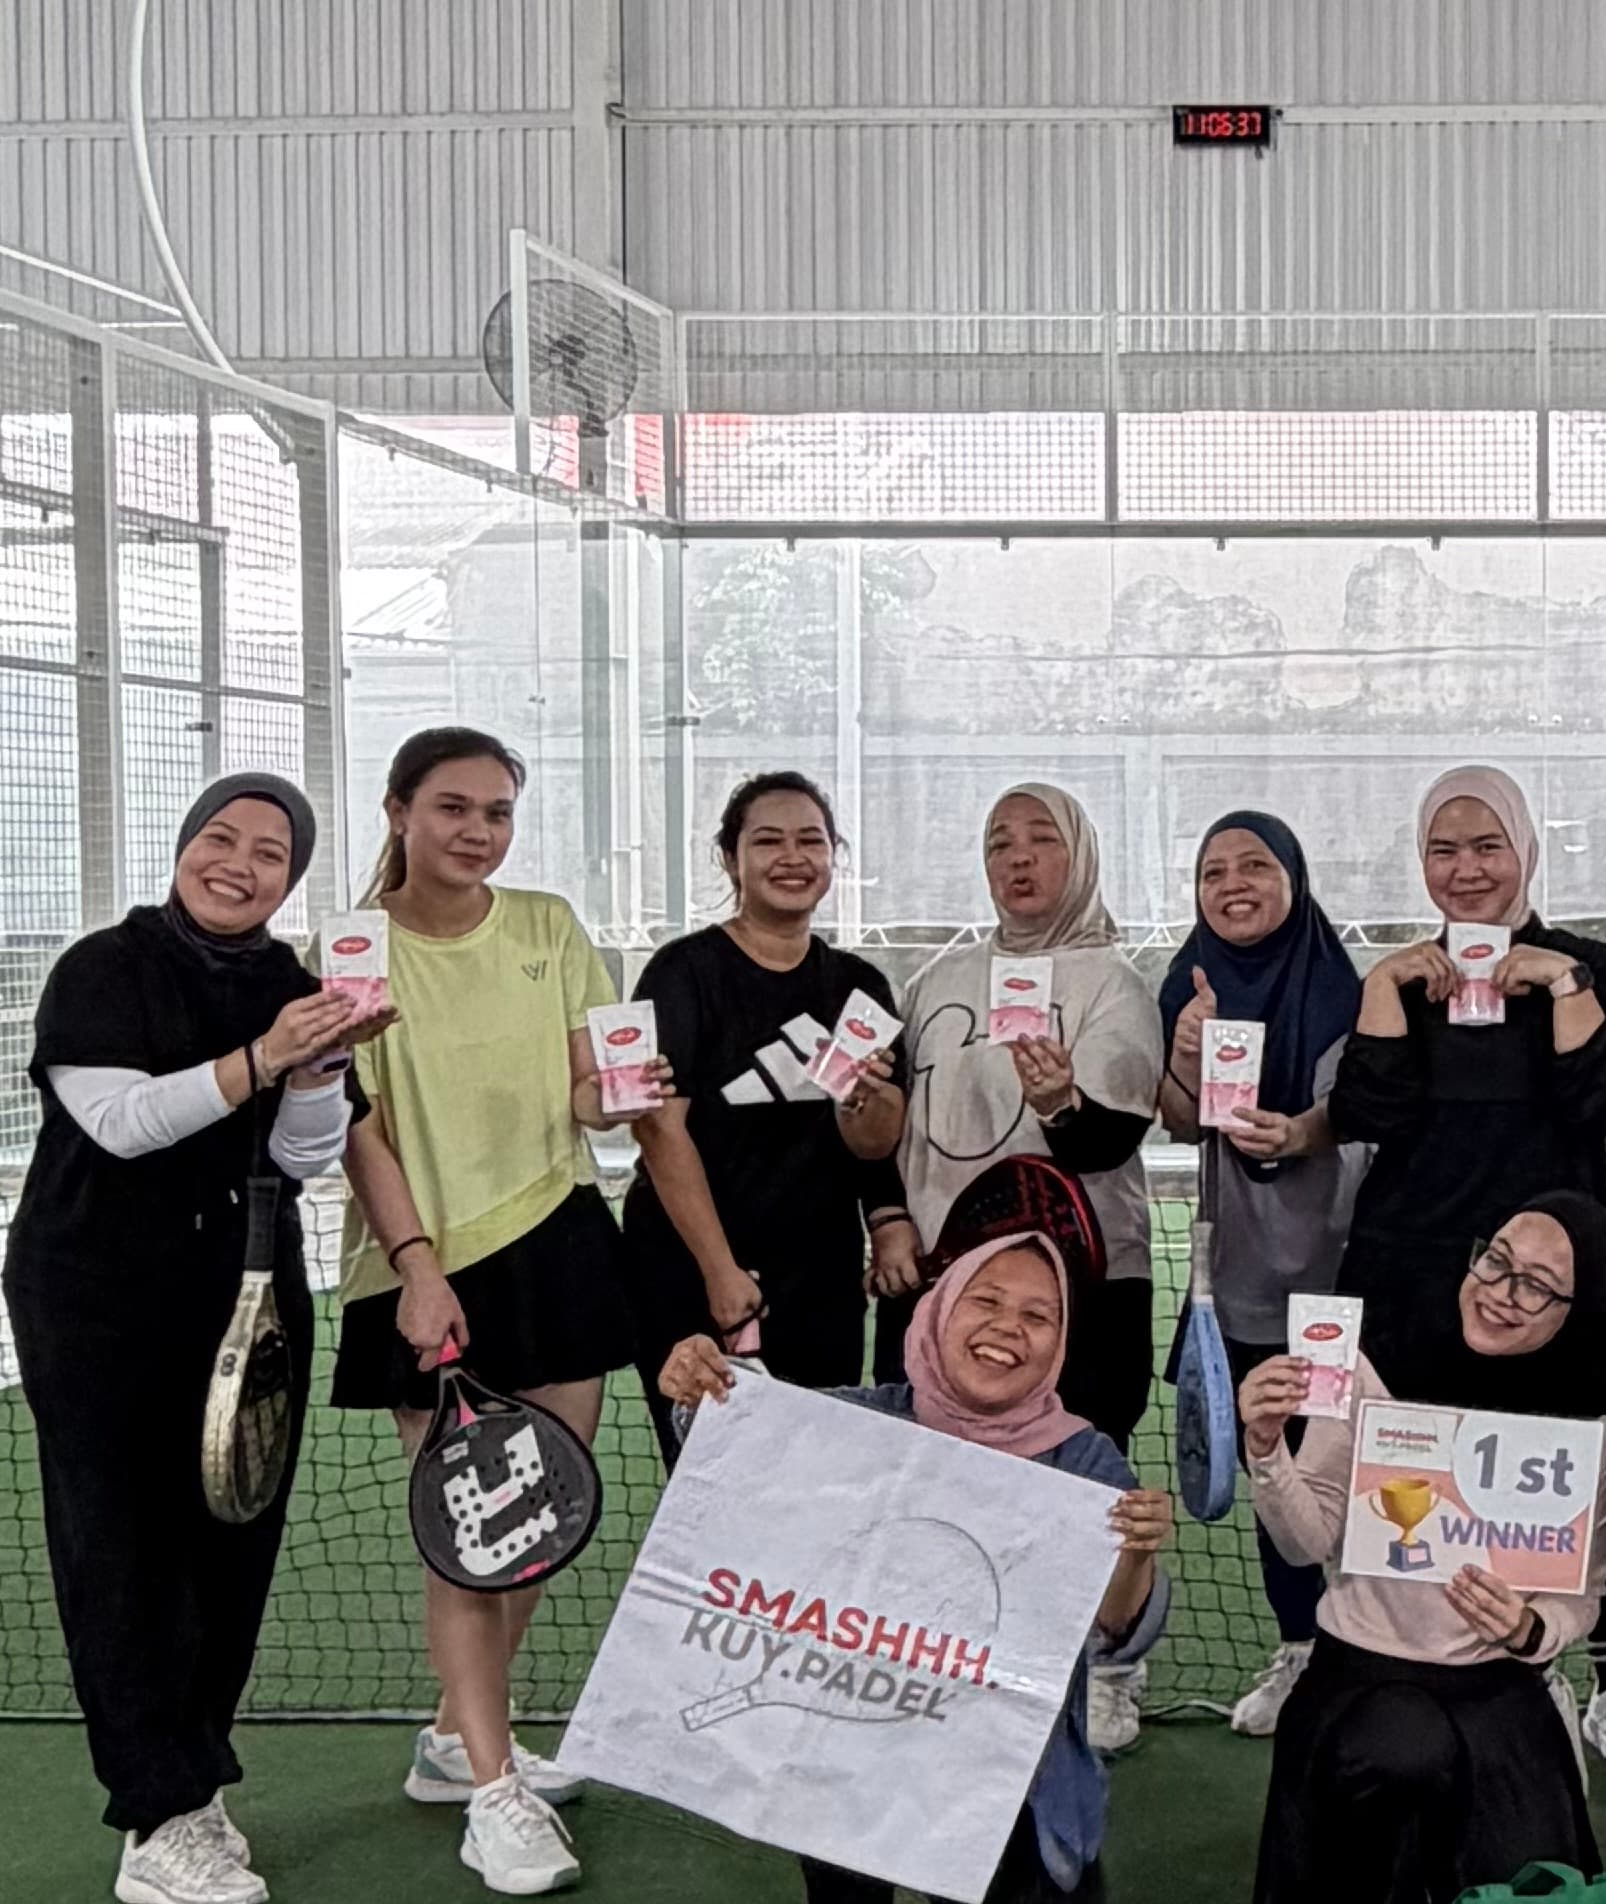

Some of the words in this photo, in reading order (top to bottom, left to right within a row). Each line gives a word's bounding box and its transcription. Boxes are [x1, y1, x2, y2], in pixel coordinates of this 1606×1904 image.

[1440, 1515, 1576, 1554] WINNER
[680, 1609, 957, 1722] KUY.PADEL
[701, 1568, 999, 1690] SMASHHH.
